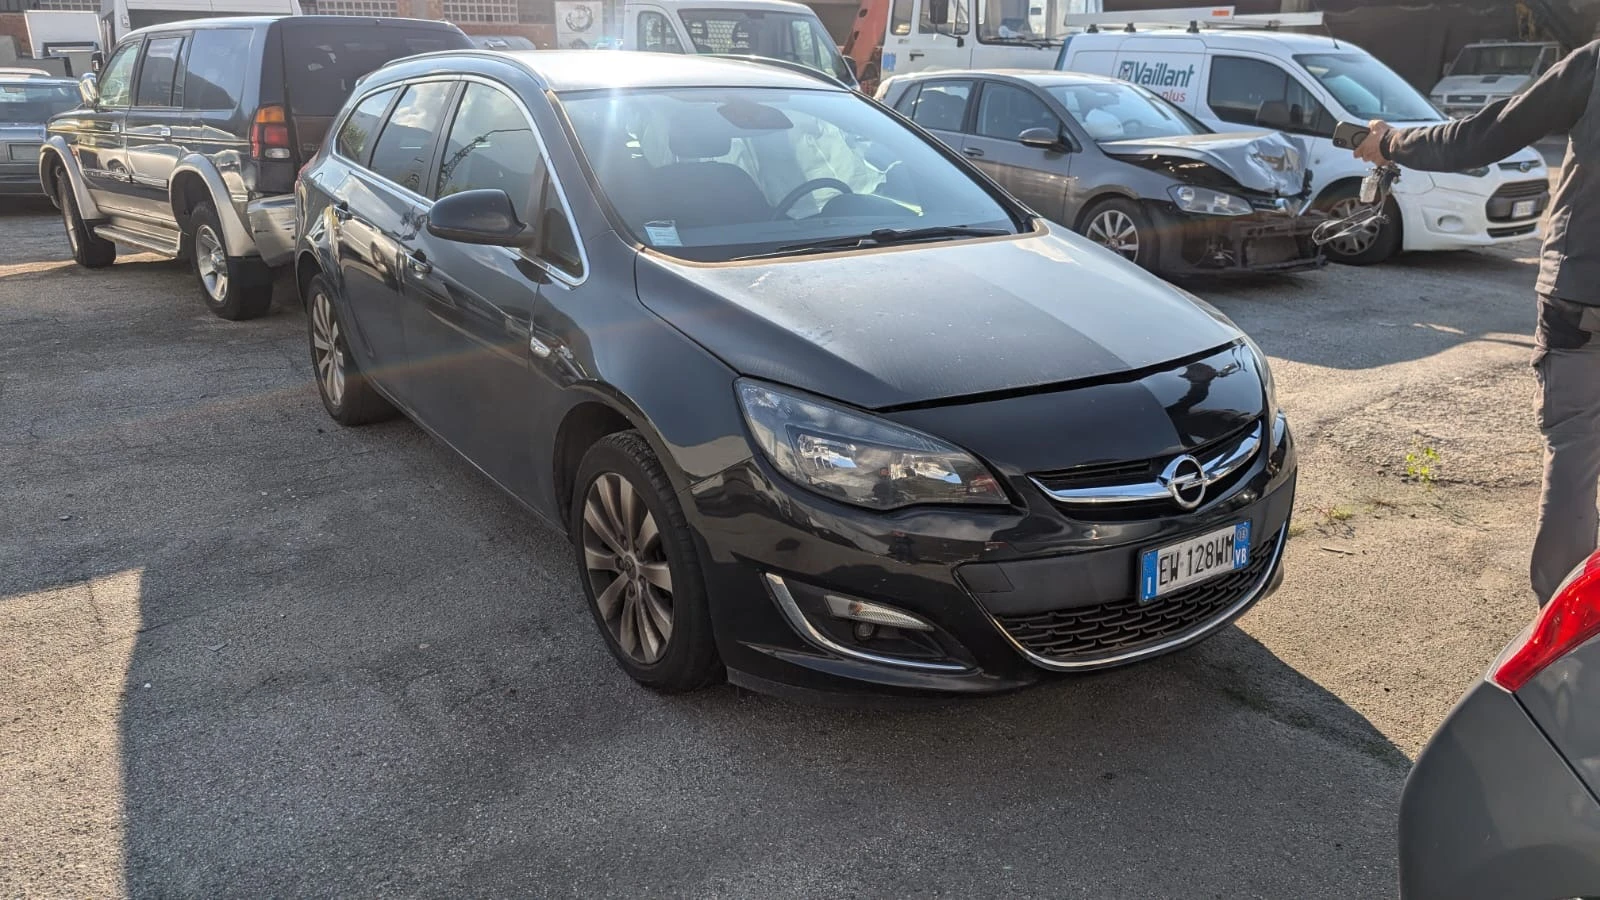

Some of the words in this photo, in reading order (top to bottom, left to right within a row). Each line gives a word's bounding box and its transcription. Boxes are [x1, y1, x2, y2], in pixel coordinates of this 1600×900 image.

[1134, 61, 1194, 87] Vaillant
[1159, 551, 1179, 586] EW
[1187, 533, 1235, 577] 128WM
[1235, 548, 1247, 565] VB
